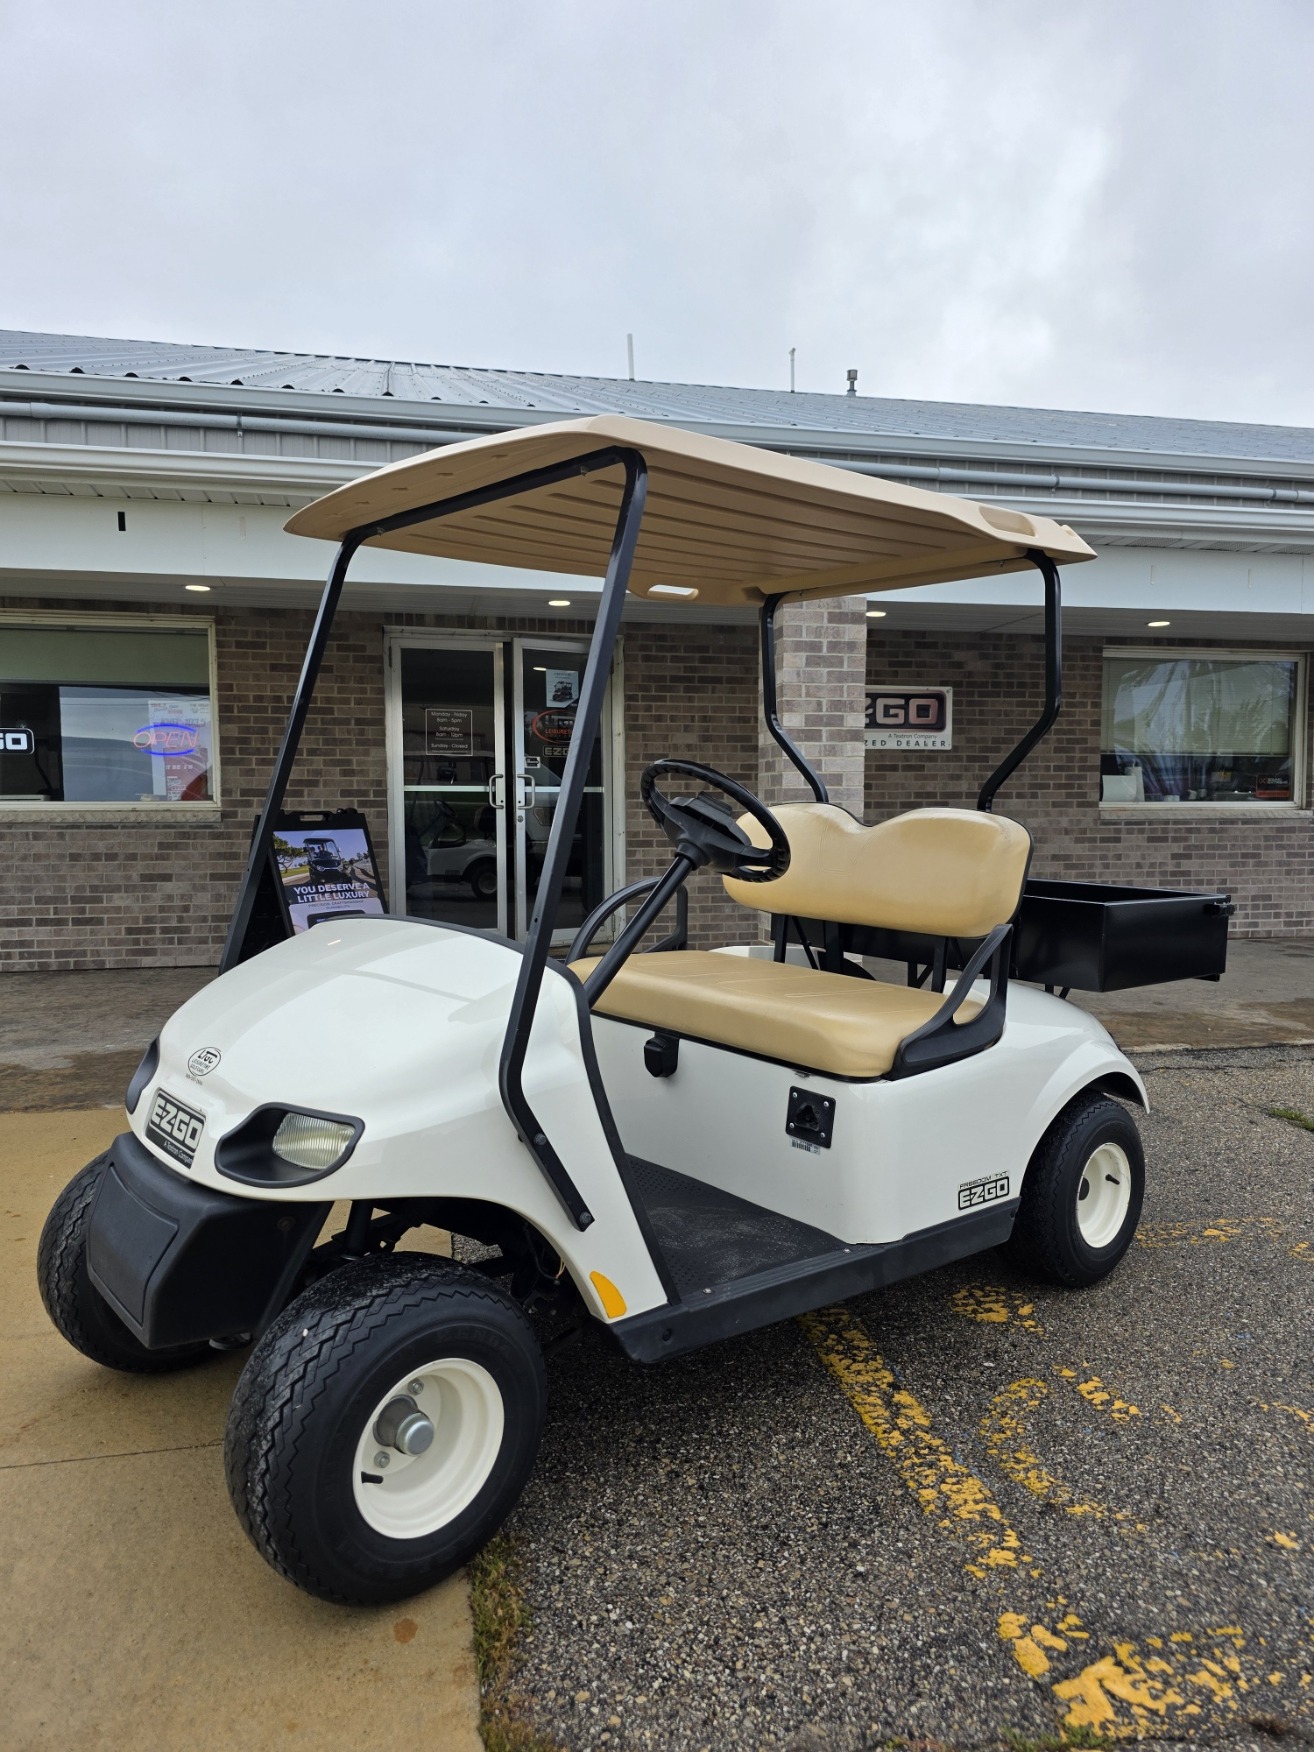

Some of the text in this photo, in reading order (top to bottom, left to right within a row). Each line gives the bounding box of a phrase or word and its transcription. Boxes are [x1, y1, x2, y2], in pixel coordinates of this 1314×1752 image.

[866, 698, 938, 725] GO
[0, 733, 28, 750] O
[134, 731, 199, 748] OPEN
[294, 886, 315, 894] YOU
[318, 883, 361, 892] DESERVE
[298, 891, 370, 902] LITTLE LUXURY
